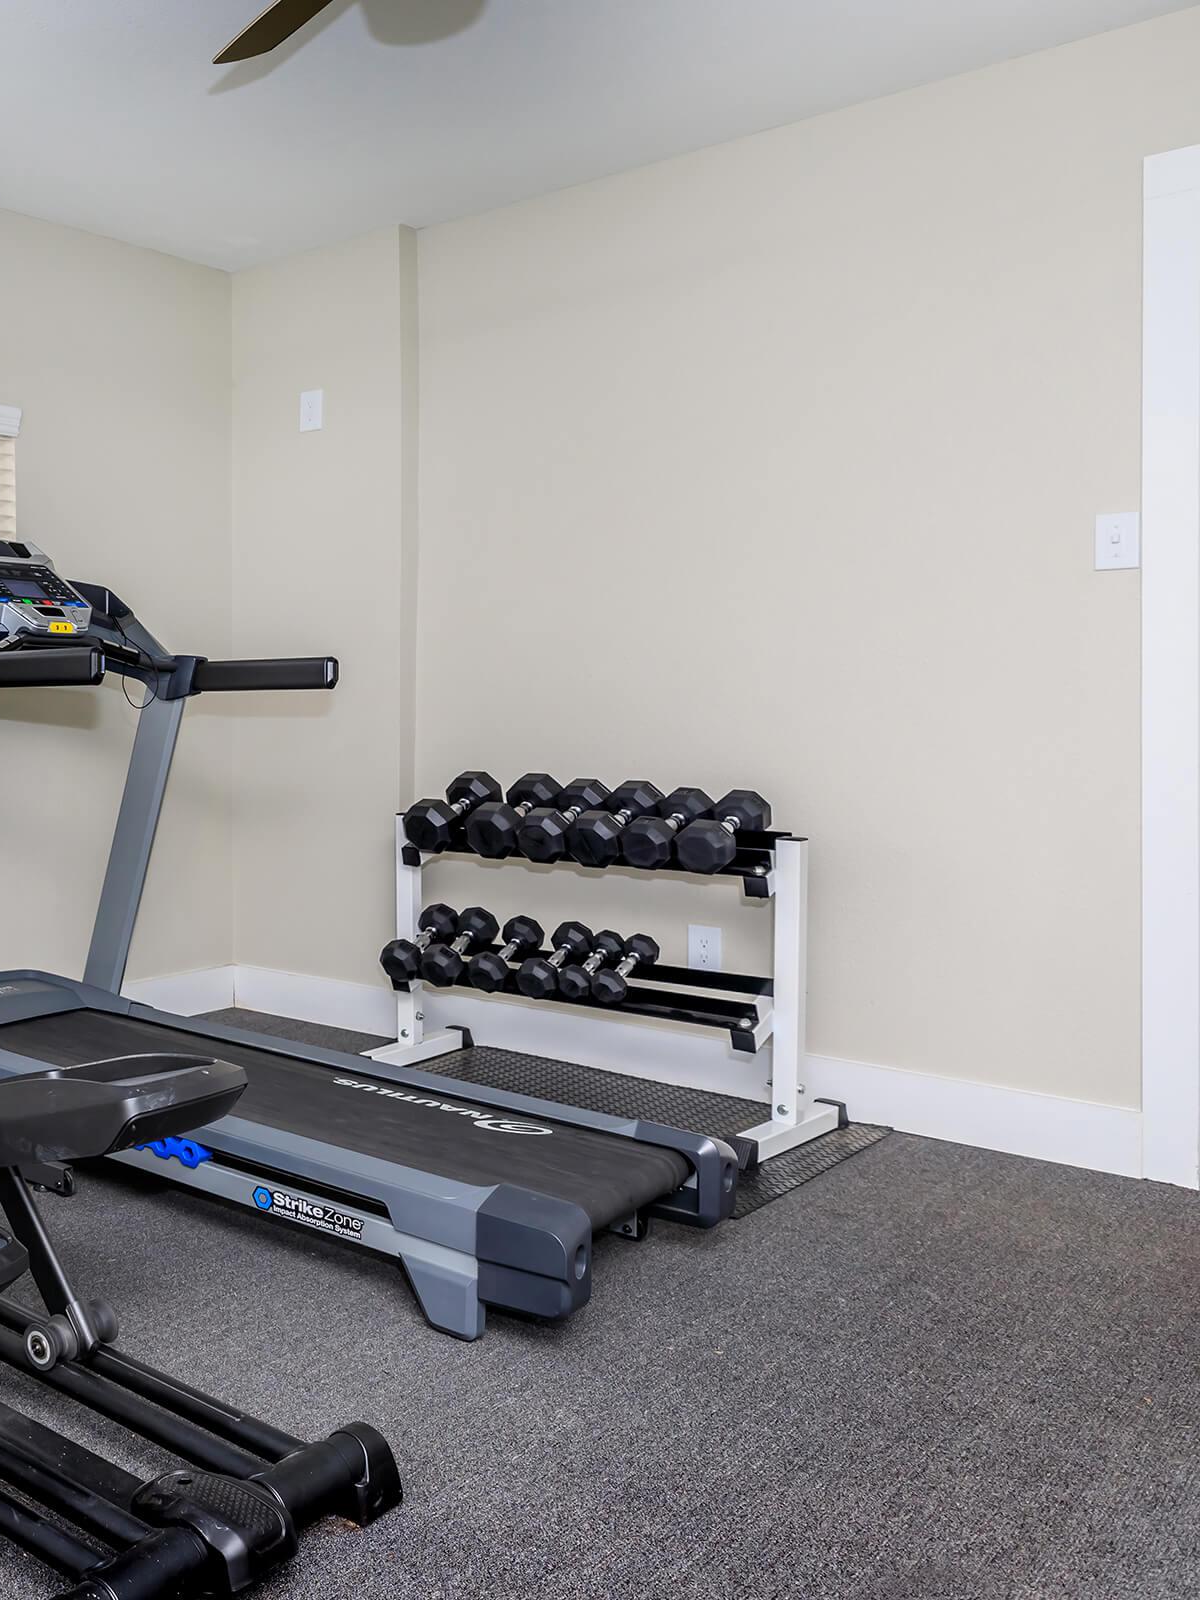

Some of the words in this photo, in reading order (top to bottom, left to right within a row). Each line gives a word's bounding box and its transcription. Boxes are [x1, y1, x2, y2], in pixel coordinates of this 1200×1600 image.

[333, 1076, 493, 1120] NAUTILUS
[272, 1204, 296, 1219] Impact
[296, 1212, 334, 1230] Absorption
[334, 1224, 361, 1239] System
